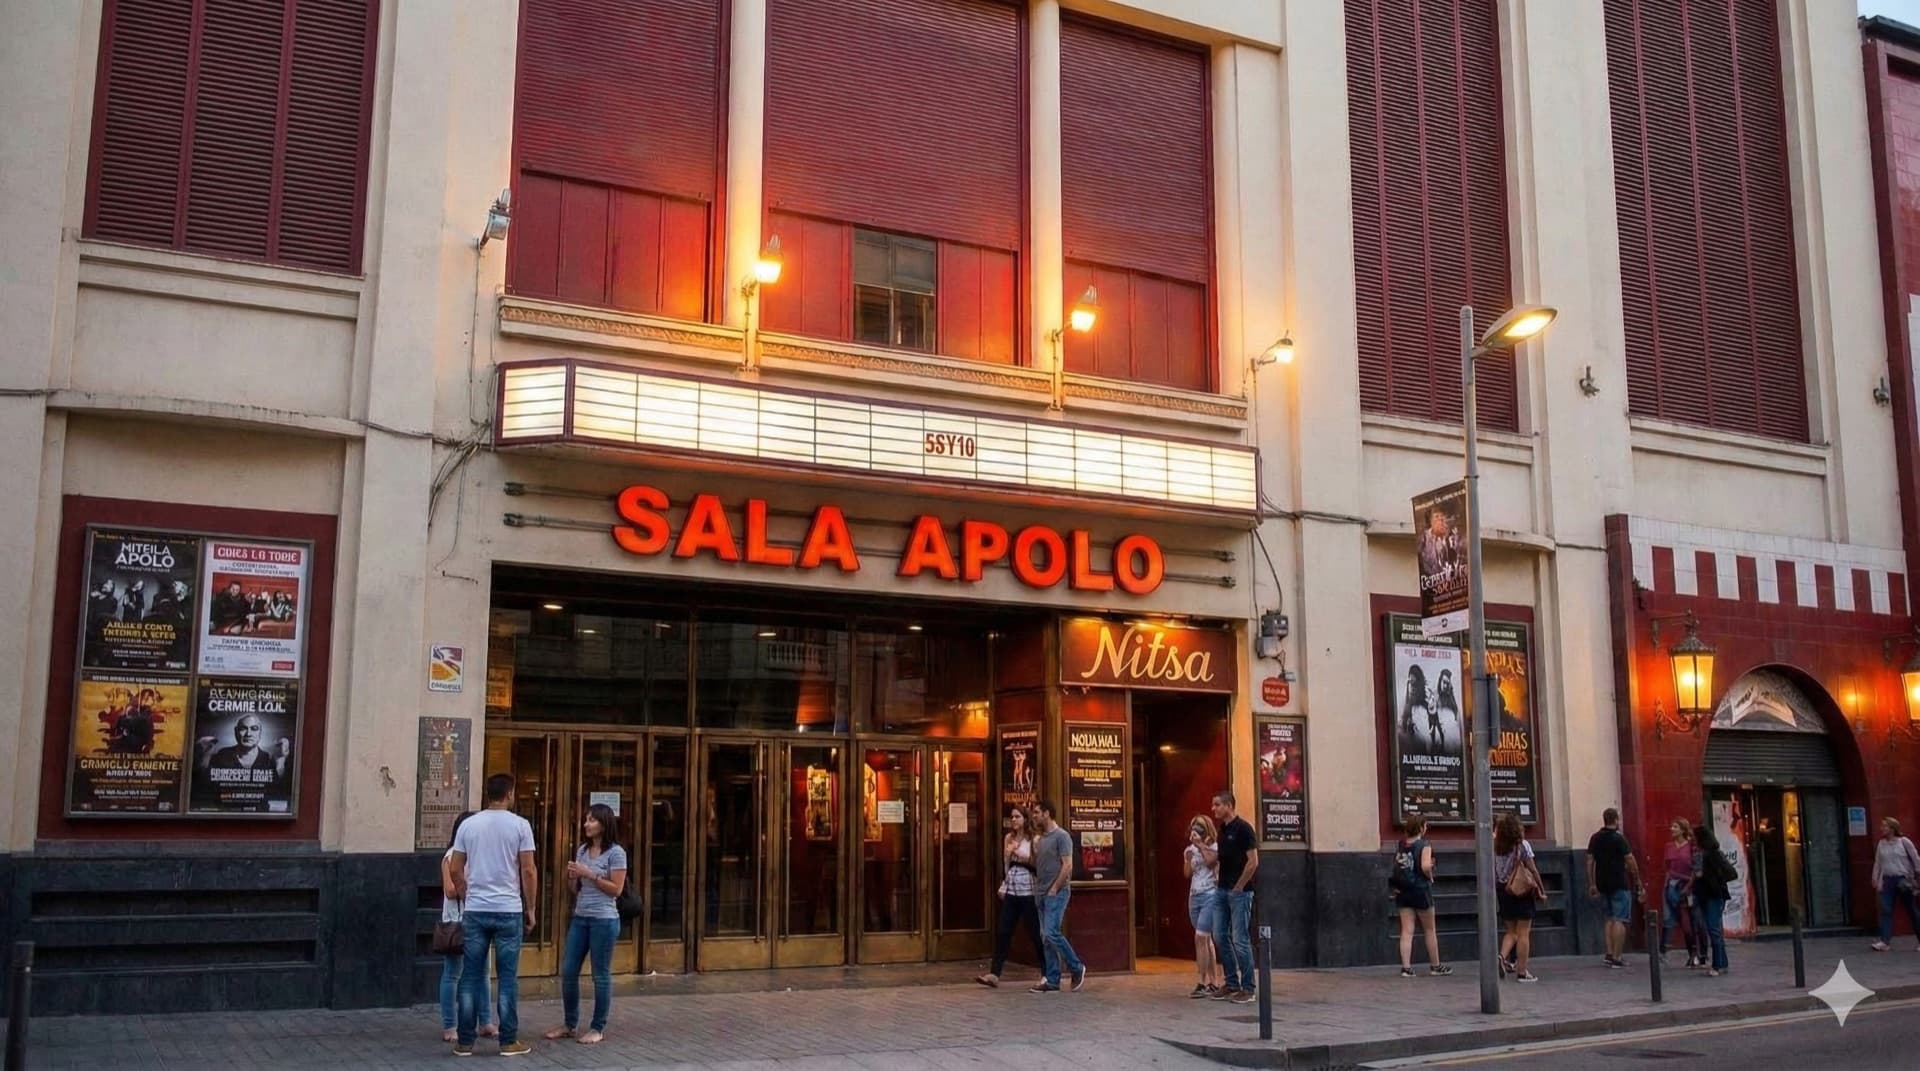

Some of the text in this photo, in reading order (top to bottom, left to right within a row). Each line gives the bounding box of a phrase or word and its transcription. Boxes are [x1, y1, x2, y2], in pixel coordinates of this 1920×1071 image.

[925, 433, 975, 457] 5SY10
[611, 484, 1167, 595] SALA APOLO
[115, 552, 175, 568] APOLO
[1081, 625, 1215, 682] Nitsa
